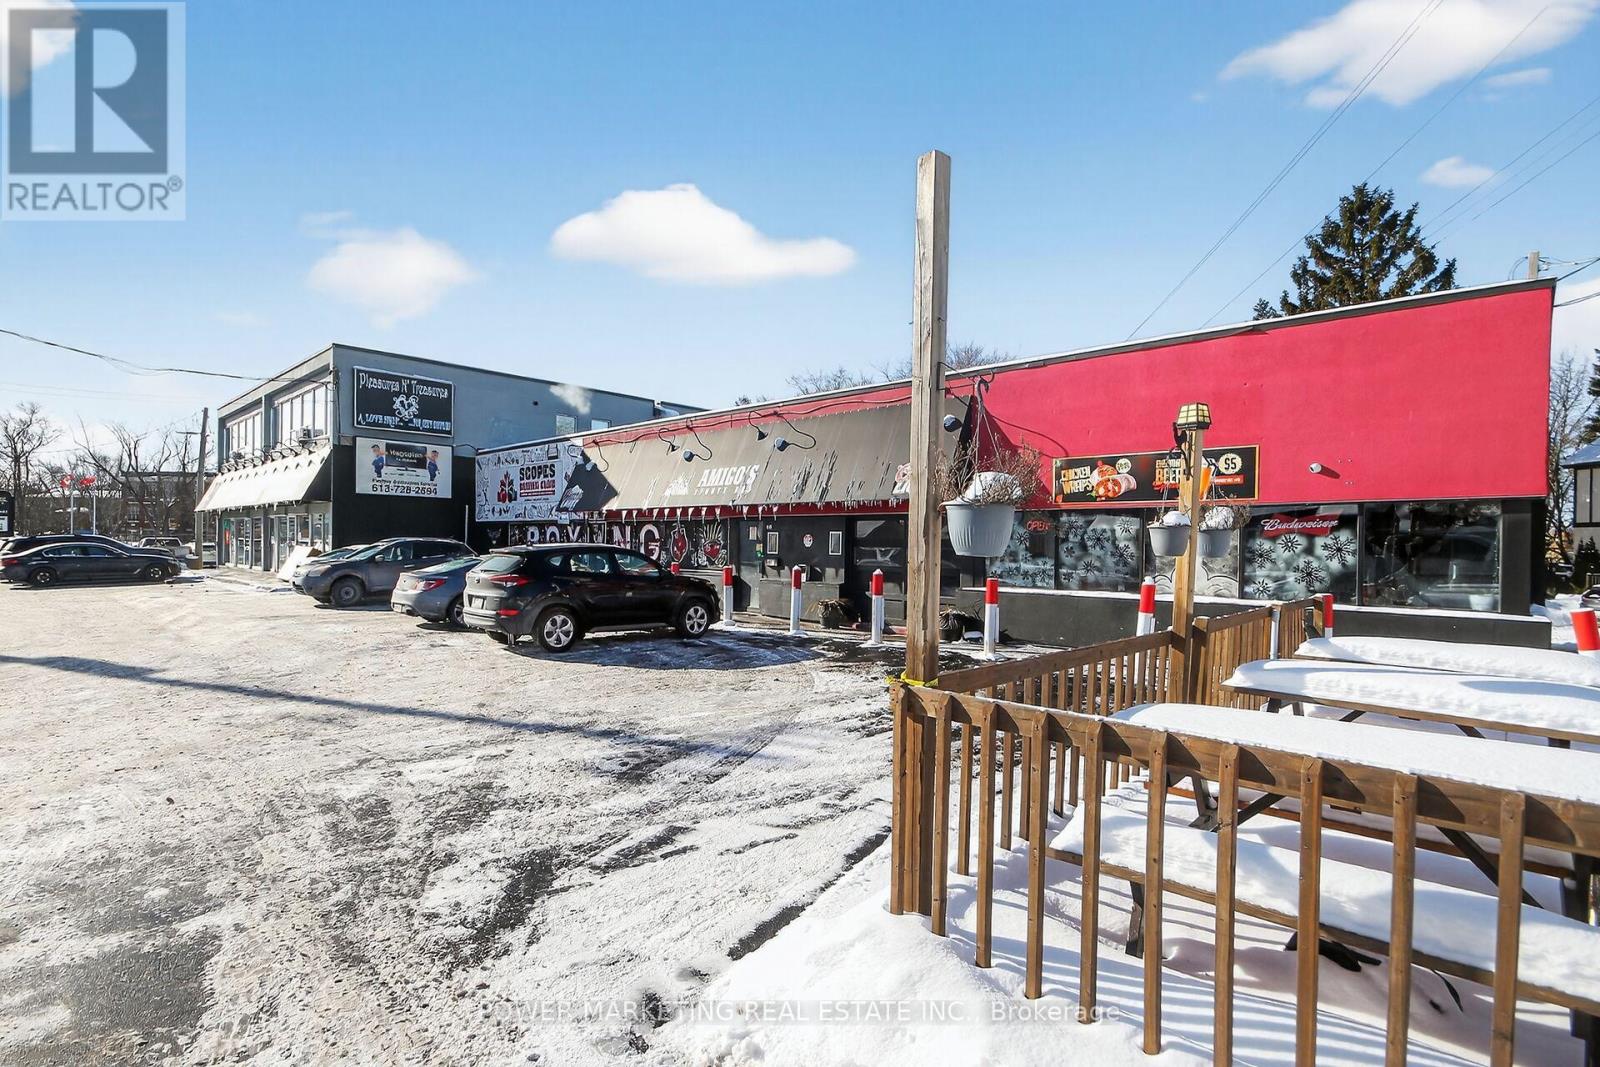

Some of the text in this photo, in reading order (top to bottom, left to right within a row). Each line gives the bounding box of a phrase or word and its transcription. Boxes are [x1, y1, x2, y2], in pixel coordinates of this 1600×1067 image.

[359, 373, 400, 392] Pleasures
[411, 380, 449, 399] Treasures
[519, 463, 556, 480] SCOPES
[1061, 478, 1093, 495] WRAPS
[1261, 518, 1339, 531] Budweiser
